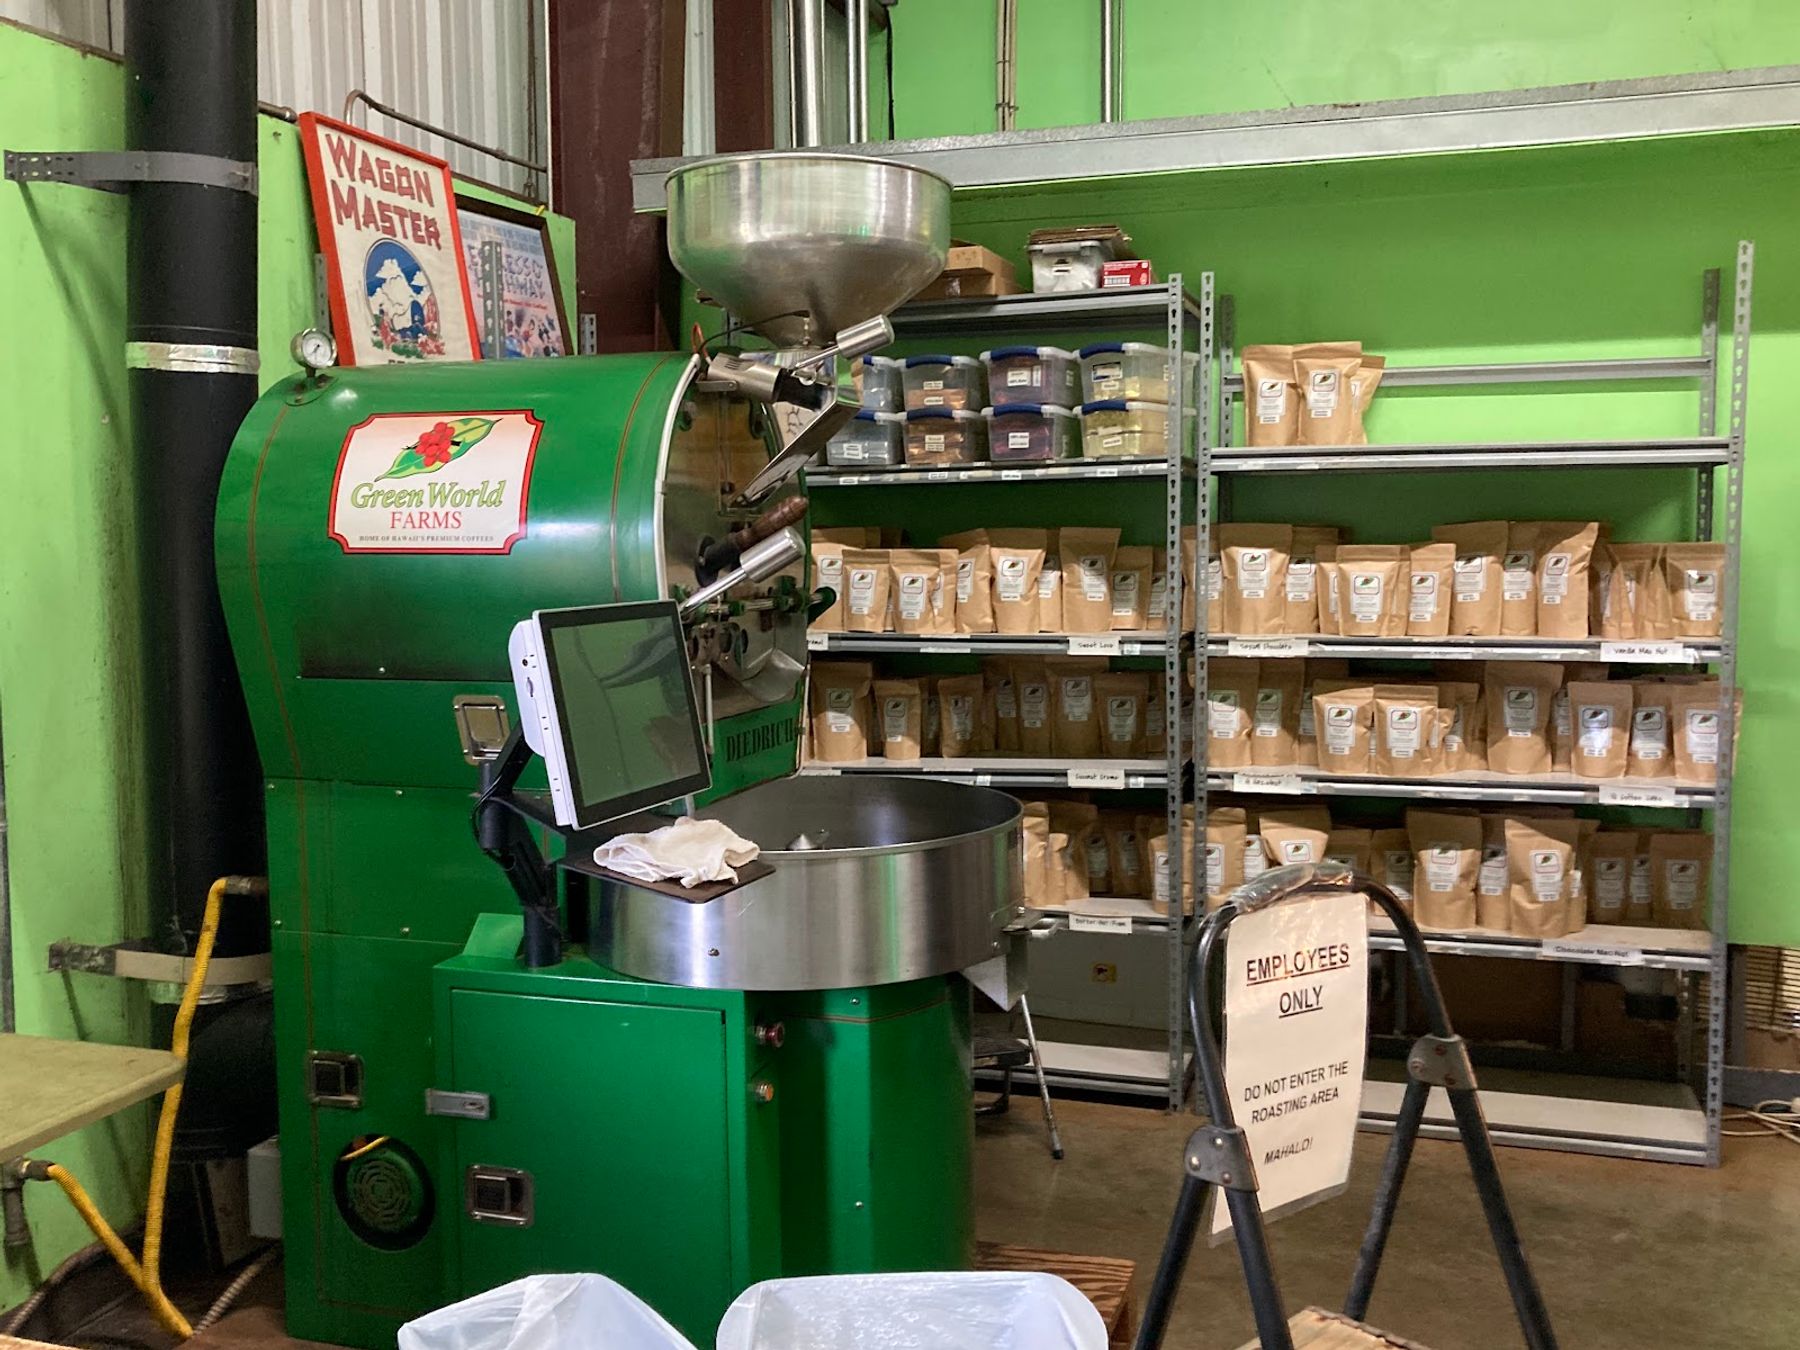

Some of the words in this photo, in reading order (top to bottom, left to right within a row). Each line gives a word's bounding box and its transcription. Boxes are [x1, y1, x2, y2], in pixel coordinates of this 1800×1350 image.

[325, 134, 434, 207] WAGON
[331, 180, 441, 250] MASTER
[351, 482, 424, 509] Green
[428, 480, 506, 509] World
[390, 511, 462, 529] FARMS
[726, 718, 793, 762] DIEDRICH
[1246, 943, 1350, 983] EMPLOYEES
[1279, 985, 1323, 1014] ONLY
[1245, 1084, 1261, 1102] DO
[1264, 1077, 1287, 1097] NOT
[1290, 1068, 1325, 1090] ENTER
[1328, 1061, 1348, 1079] THE
[1252, 1096, 1308, 1124] ROASTING
[1310, 1087, 1339, 1107] AREA
[1264, 1138, 1313, 1165] MAHALO!
